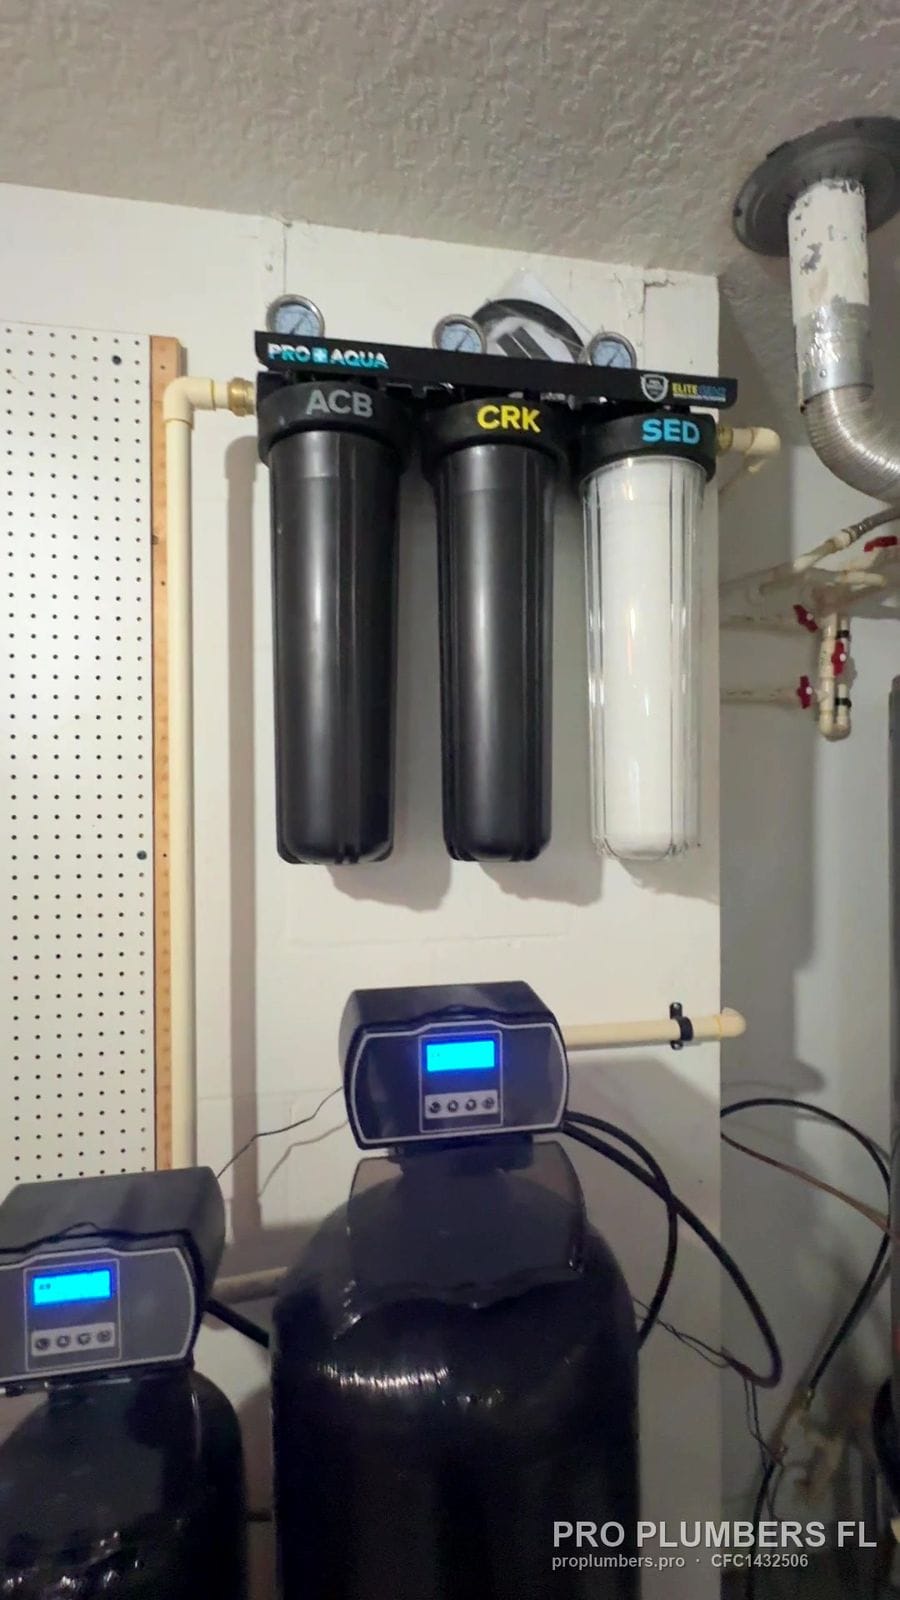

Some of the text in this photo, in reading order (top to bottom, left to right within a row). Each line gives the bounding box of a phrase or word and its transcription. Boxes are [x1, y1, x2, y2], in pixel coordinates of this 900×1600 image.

[267, 342, 389, 370] PRO AQUA
[306, 389, 374, 418] ACB
[477, 404, 541, 434] CRK
[642, 418, 700, 445] SED
